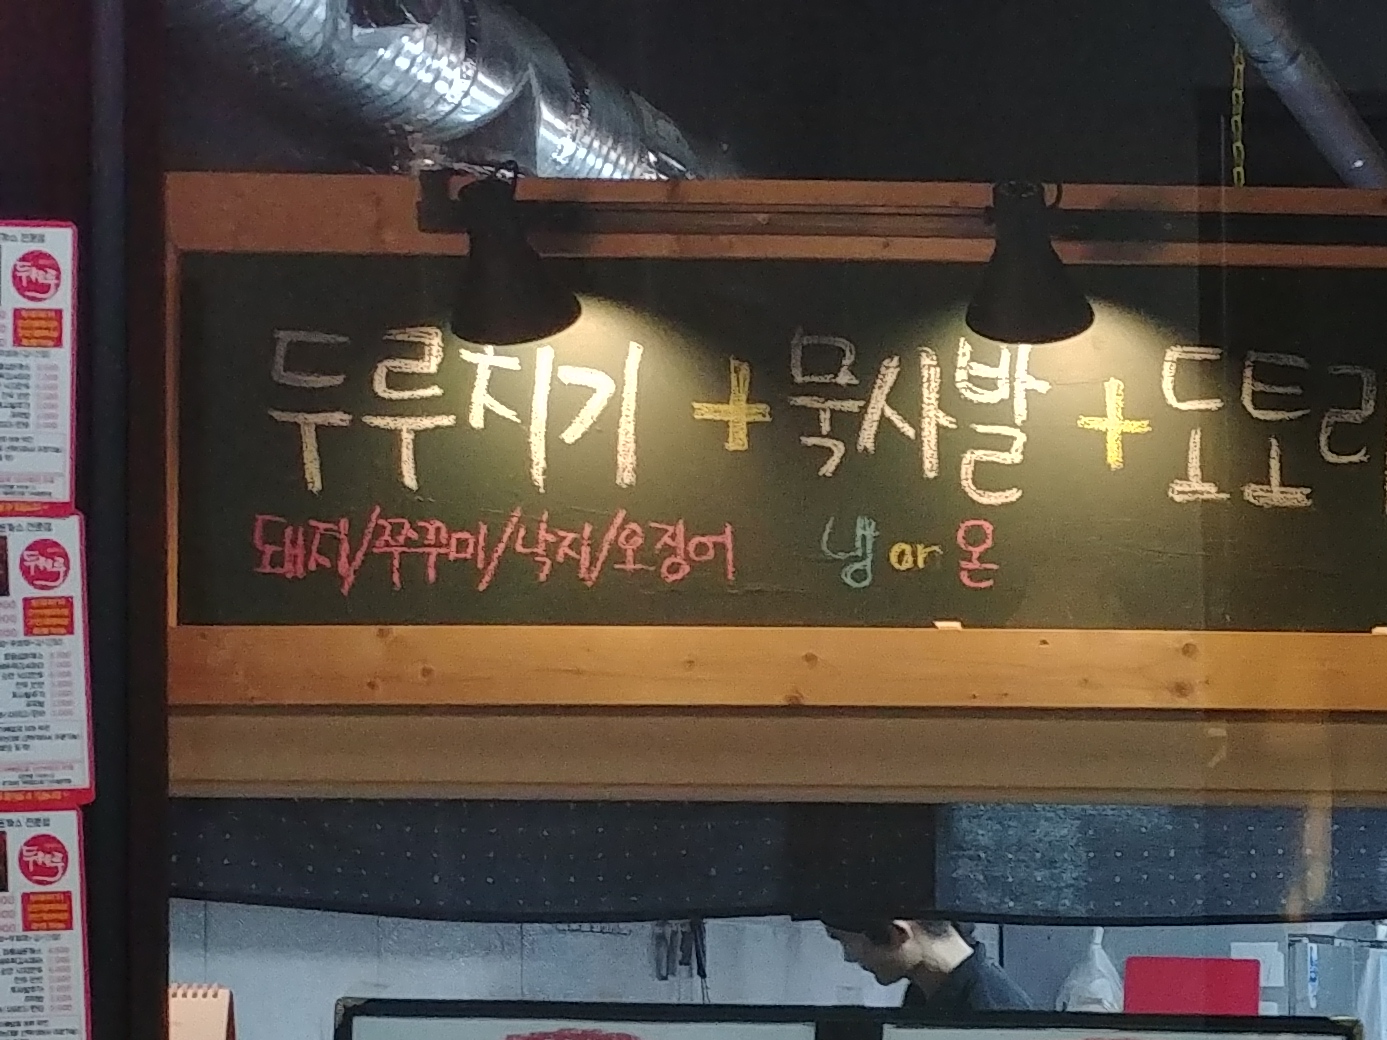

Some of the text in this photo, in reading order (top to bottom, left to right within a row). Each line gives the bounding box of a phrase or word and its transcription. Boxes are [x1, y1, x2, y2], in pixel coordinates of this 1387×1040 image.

[267, 329, 646, 494] 두루치기
[788, 333, 1051, 505] 묵사발
[821, 516, 878, 590] 냉
[889, 538, 943, 573] or
[955, 518, 1000, 590] 온
